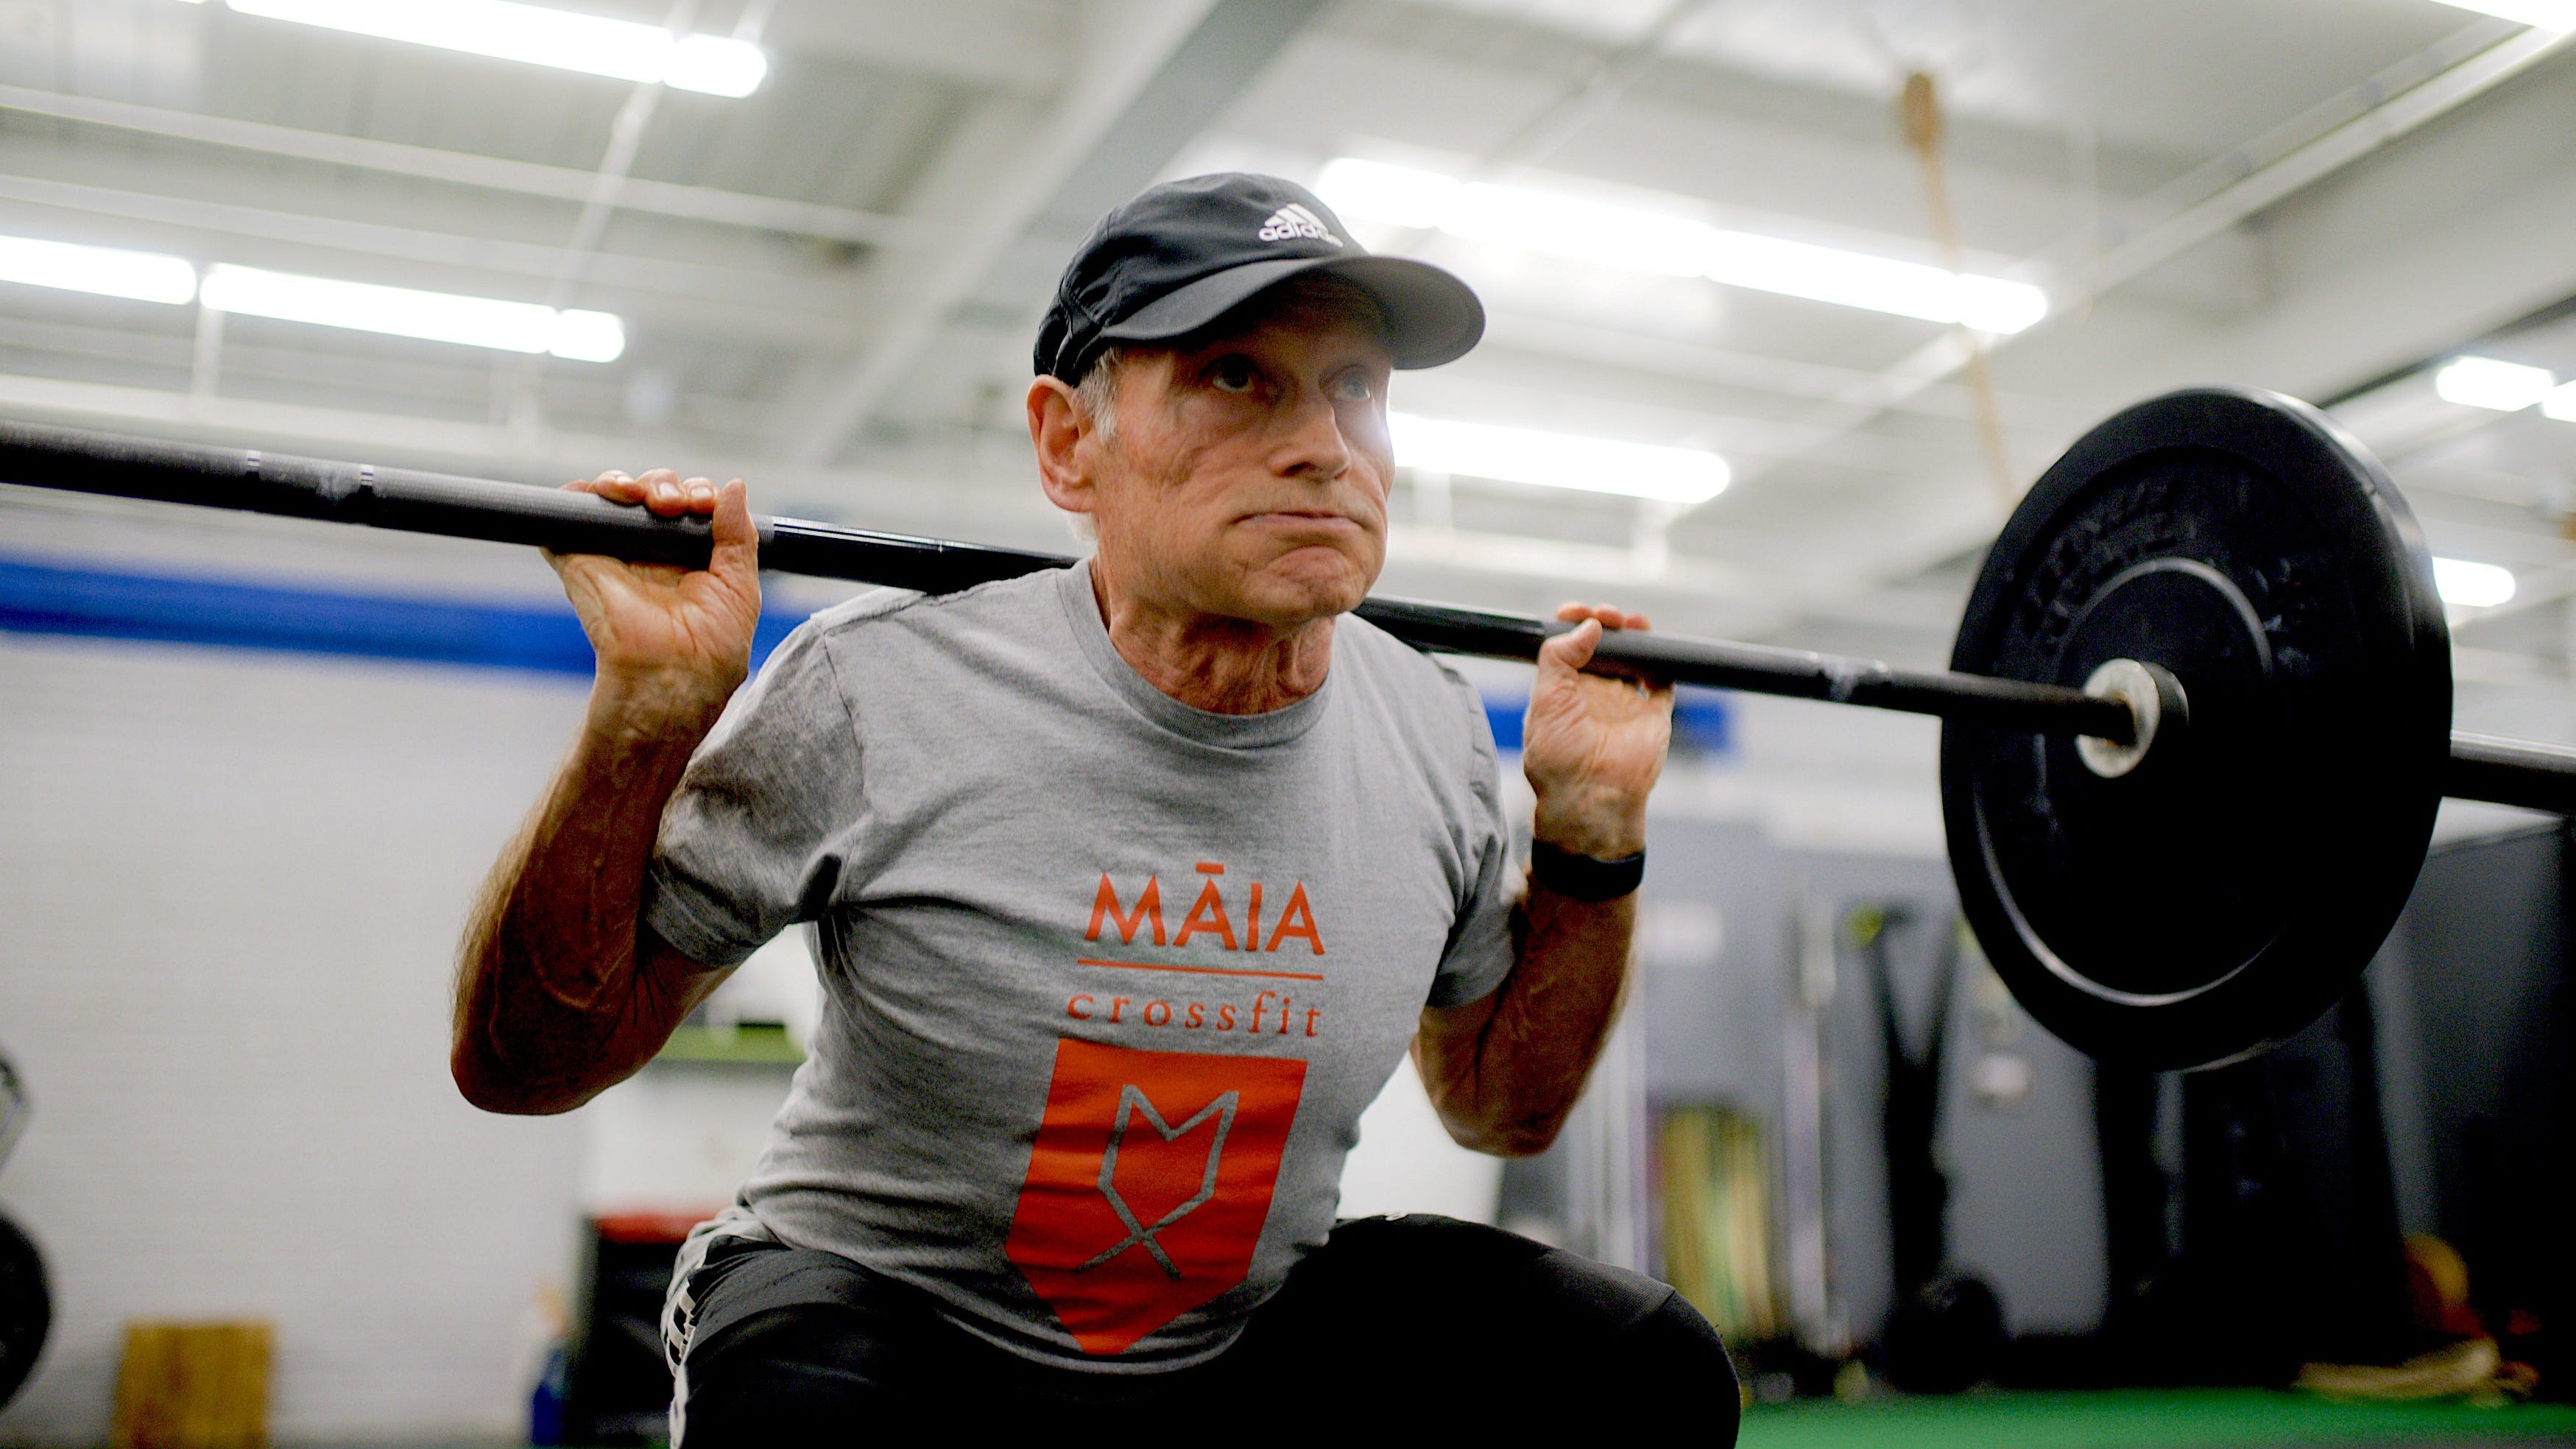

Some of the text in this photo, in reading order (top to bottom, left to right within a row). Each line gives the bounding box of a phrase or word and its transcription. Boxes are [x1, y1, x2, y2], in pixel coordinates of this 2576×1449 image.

[1258, 221, 1344, 247] adidas
[1084, 861, 1325, 956] MĀIA
[1067, 990, 1321, 1037] crossfit
